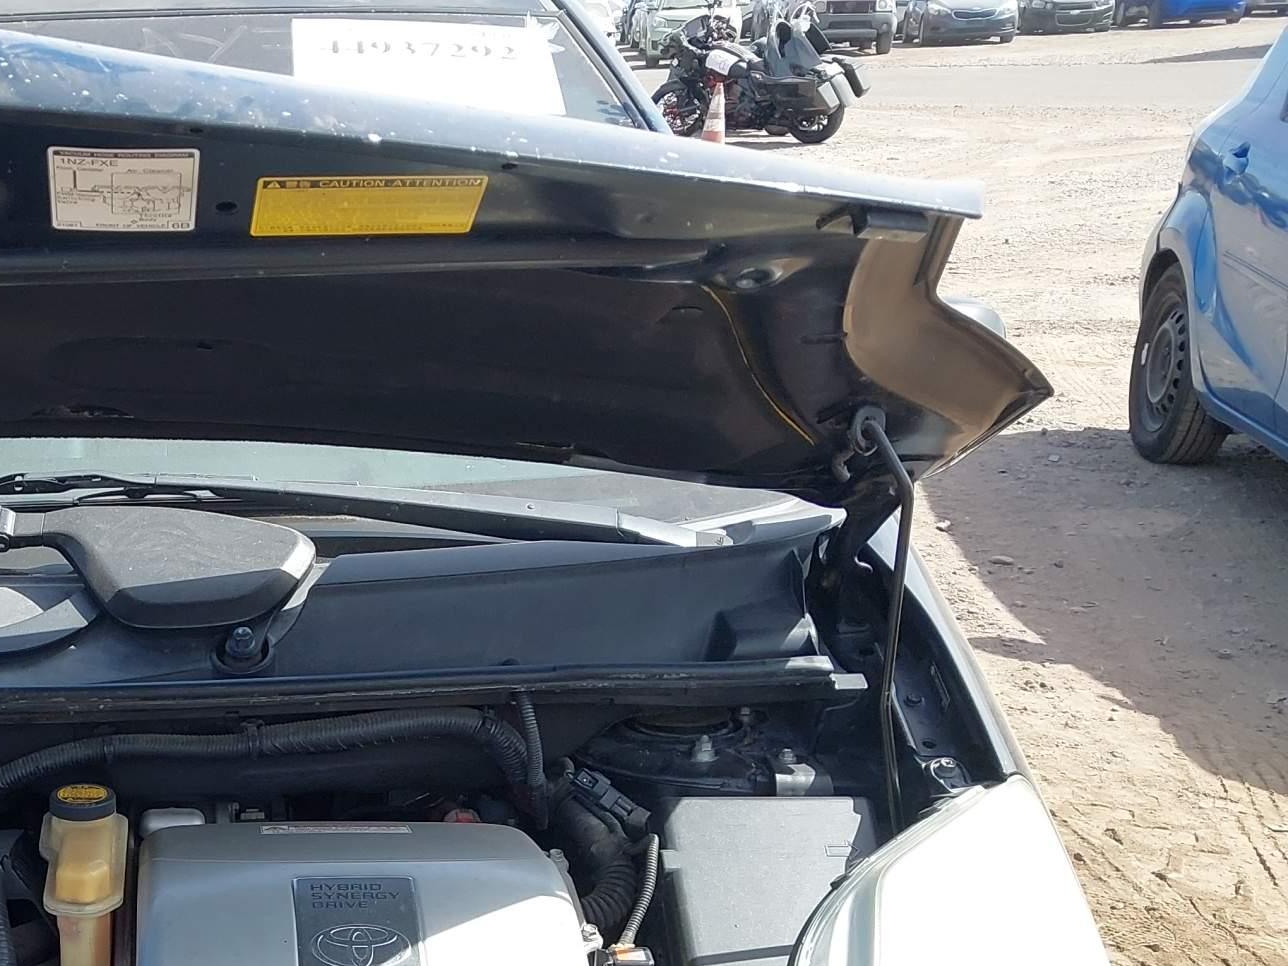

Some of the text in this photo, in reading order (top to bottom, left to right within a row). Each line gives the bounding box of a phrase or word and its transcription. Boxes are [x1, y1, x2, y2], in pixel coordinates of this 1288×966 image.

[60, 158, 119, 167] 1NZ-FXE
[319, 179, 385, 188] CAUTION
[390, 179, 481, 188] ATTENTION
[311, 883, 382, 892] HYBRID
[311, 891, 400, 900] SYNERGY
[312, 900, 369, 909] DRIVE
